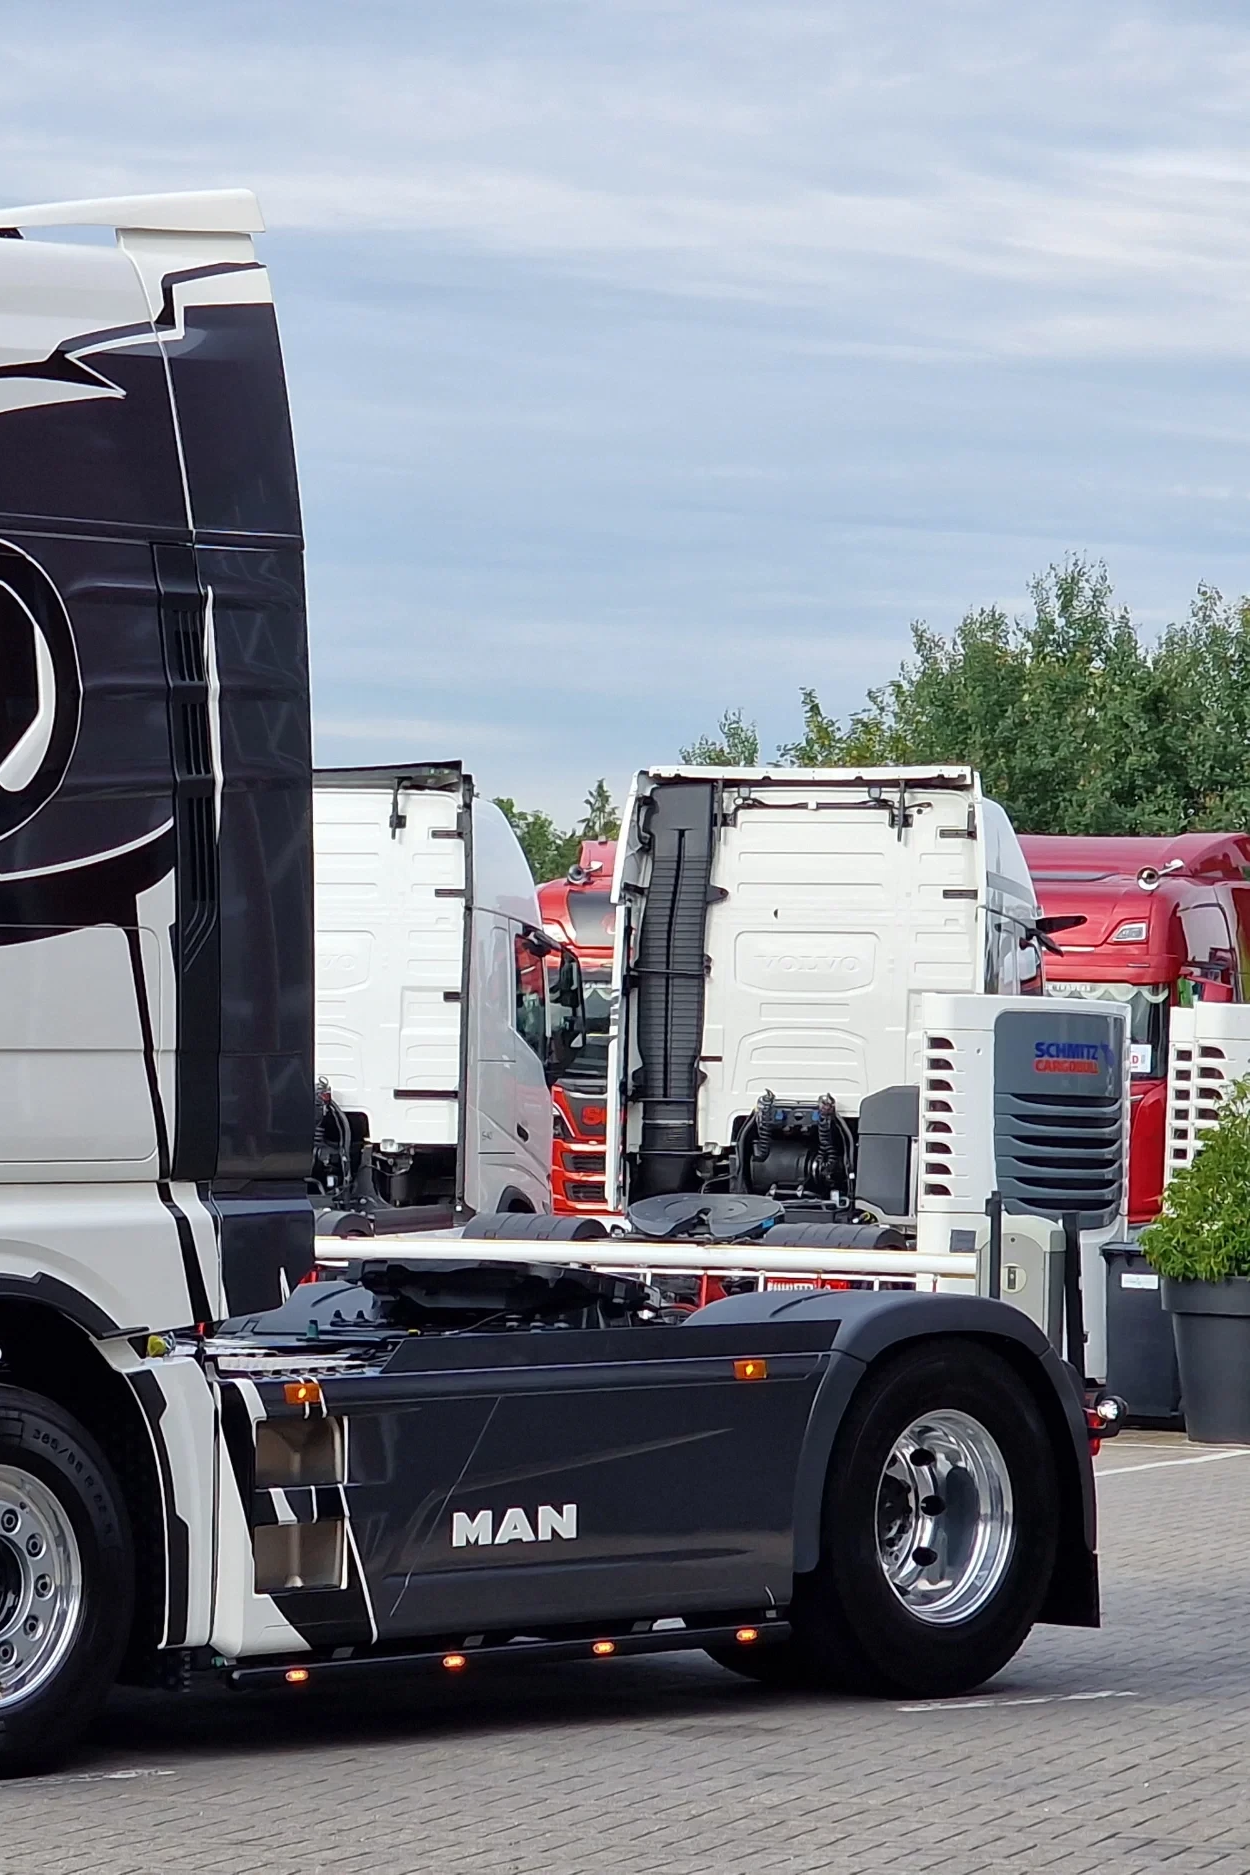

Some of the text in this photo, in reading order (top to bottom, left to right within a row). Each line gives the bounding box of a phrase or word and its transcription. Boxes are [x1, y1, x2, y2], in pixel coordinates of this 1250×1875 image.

[753, 955, 861, 971] VOLVO
[1035, 1042, 1098, 1060] SCHMITZ
[451, 1504, 578, 1547] MAN
